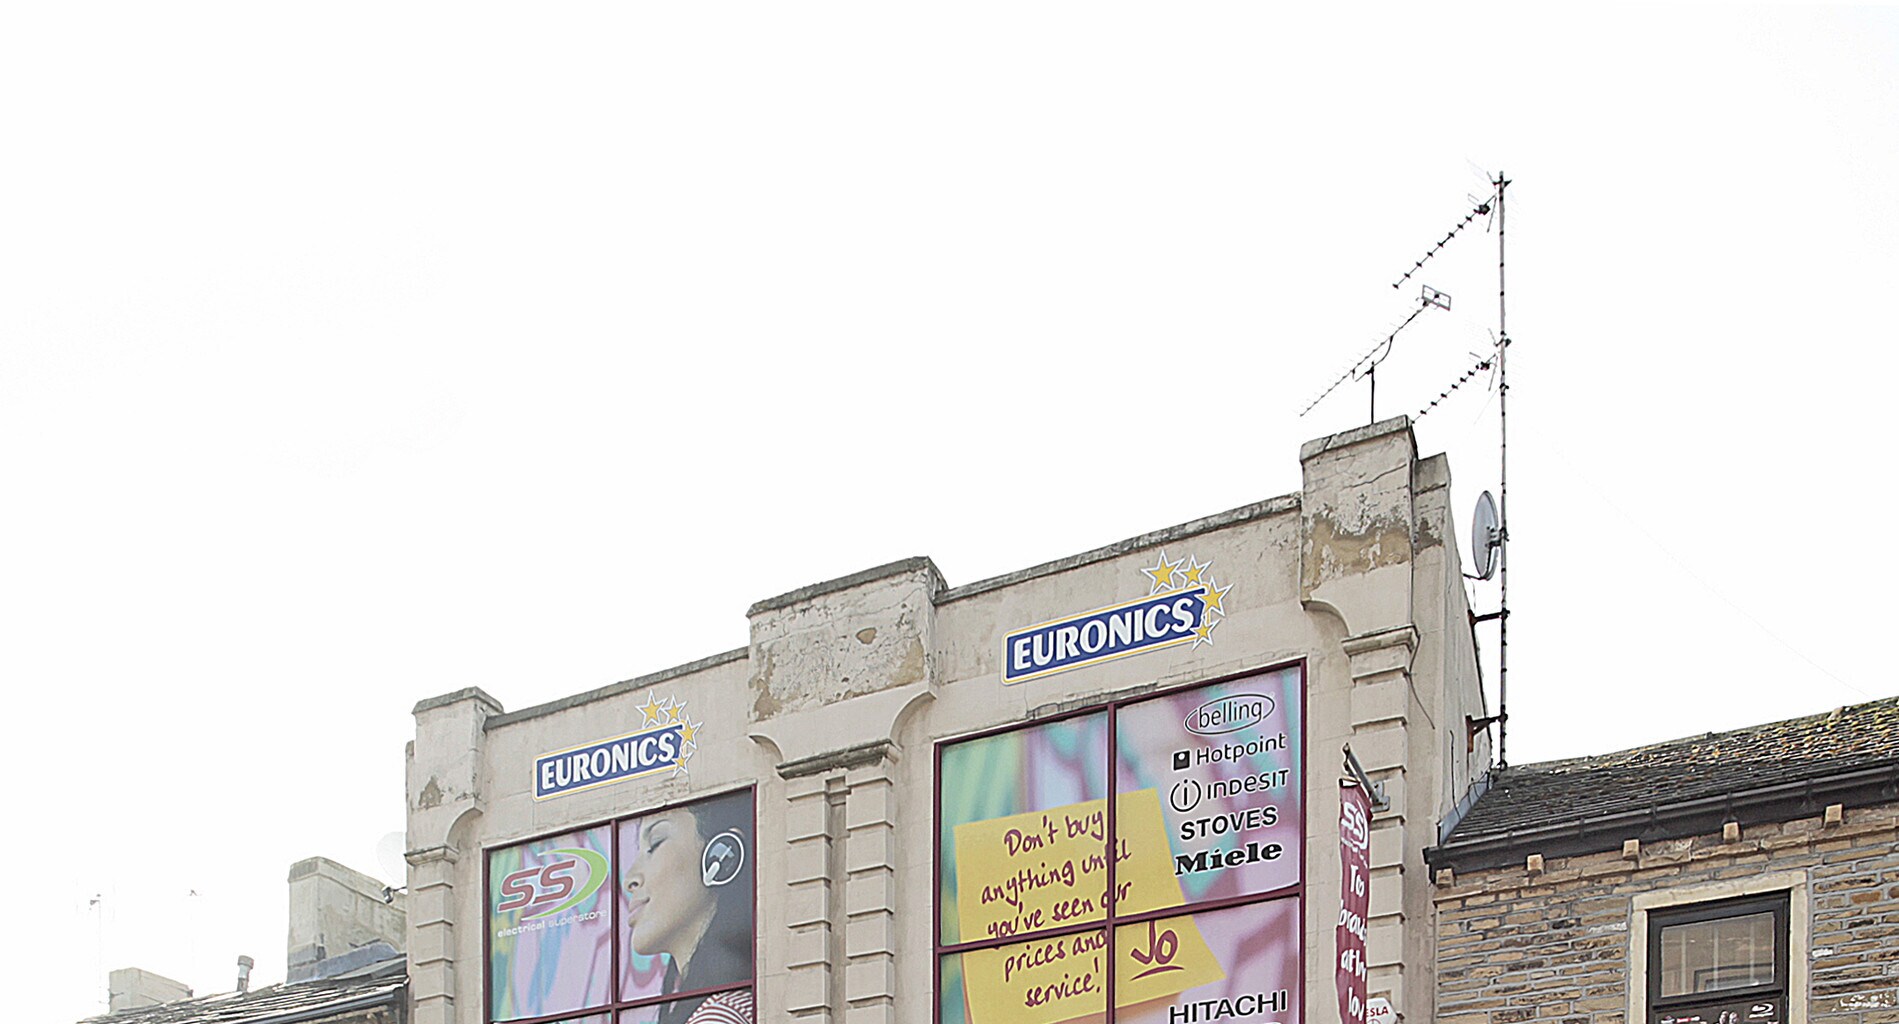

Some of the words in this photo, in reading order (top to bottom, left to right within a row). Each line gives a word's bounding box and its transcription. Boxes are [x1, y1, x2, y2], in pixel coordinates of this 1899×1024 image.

[1014, 598, 1194, 670] EURONICS
[1199, 701, 1262, 728] belling
[541, 732, 675, 790] EURONICS
[1196, 733, 1286, 763] Hotpoint
[1004, 815, 1058, 856] Don't
[1065, 811, 1104, 841] buy
[1181, 806, 1278, 840] STOVES
[1341, 802, 1364, 840] SS
[1175, 842, 1283, 876] Miele
[497, 859, 577, 913] SS
[981, 860, 1075, 906] anything
[497, 921, 545, 938] electrical
[548, 909, 608, 927] superstore
[1052, 898, 1094, 922] seen
[1005, 940, 1066, 982] prices
[1131, 920, 1178, 965] Jo
[1025, 957, 1101, 1007] service!
[1169, 991, 1286, 1024] HITACHI
